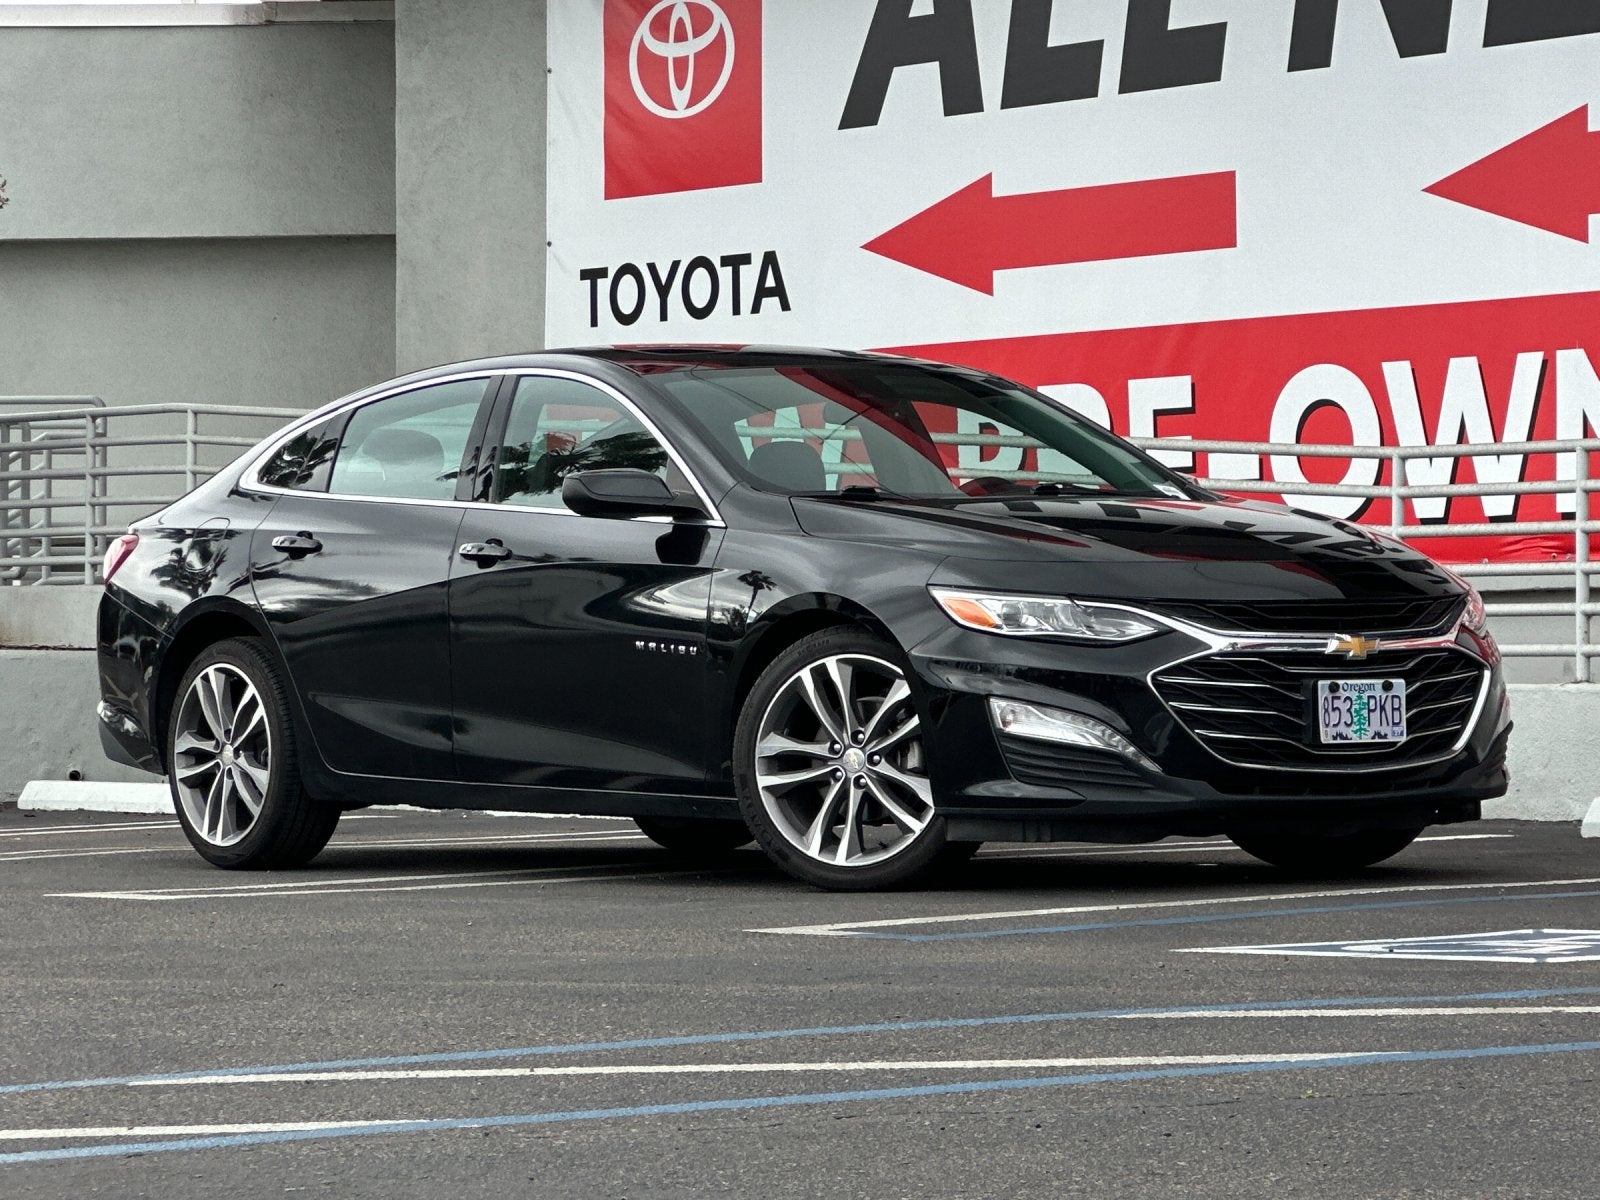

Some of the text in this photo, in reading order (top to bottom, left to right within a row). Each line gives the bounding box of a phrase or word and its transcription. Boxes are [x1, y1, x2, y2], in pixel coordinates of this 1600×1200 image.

[579, 250, 792, 328] TOYOTA
[635, 641, 697, 655] MALIBU
[1341, 682, 1376, 693] Oregon
[1323, 694, 1402, 728] 853 PKB
